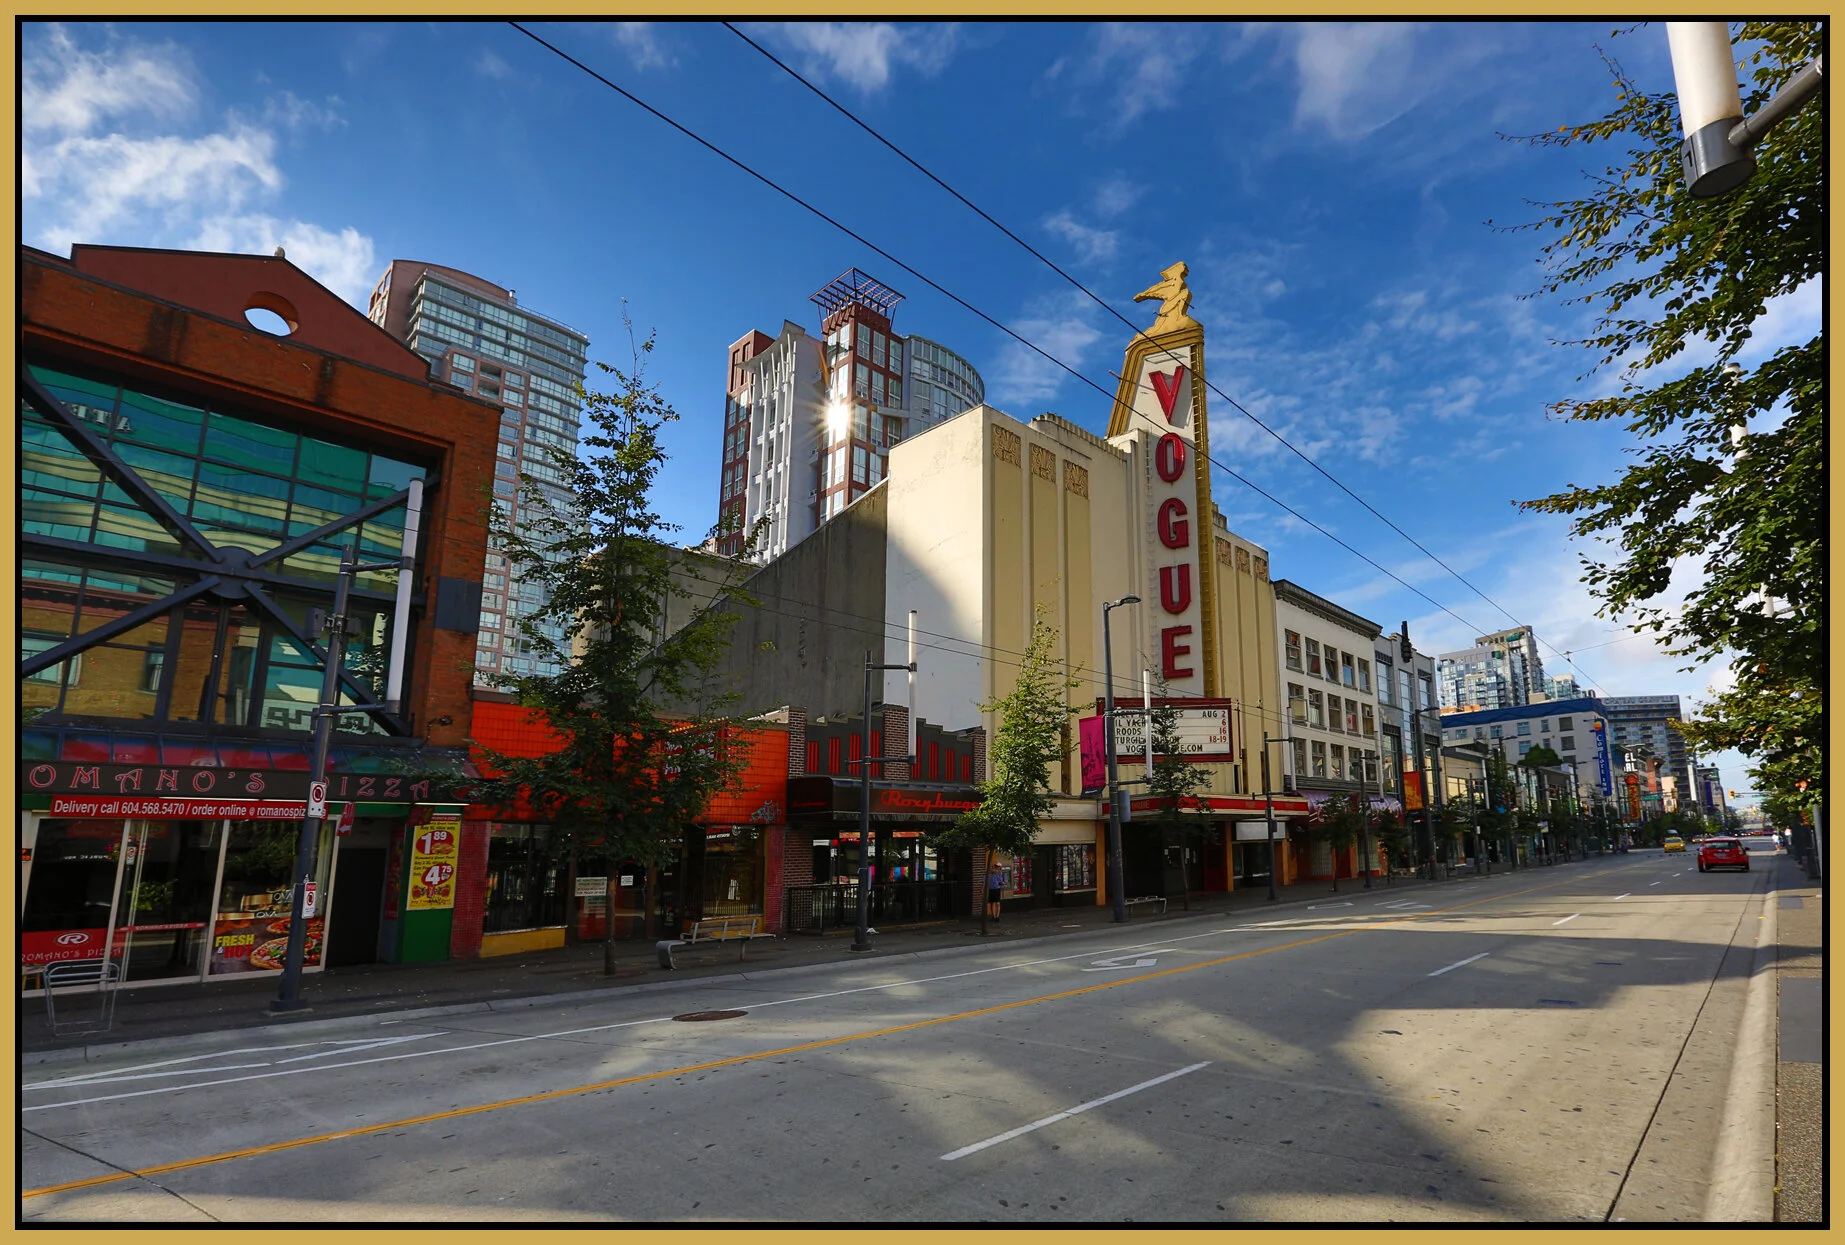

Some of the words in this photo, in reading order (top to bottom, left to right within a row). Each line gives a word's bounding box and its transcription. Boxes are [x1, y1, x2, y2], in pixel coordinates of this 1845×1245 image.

[1149, 366, 1194, 680] VOGUE
[1116, 728, 1141, 736] ROODS
[29, 764, 265, 794] OMANO'S
[324, 776, 430, 800] IZZA
[55, 800, 97, 816] Delivery
[100, 801, 119, 814] call
[121, 802, 184, 815] 604.568.5470
[192, 803, 216, 815] order
[218, 804, 246, 816] online
[880, 789, 981, 813] Roxyburge
[421, 832, 432, 855] 1
[433, 831, 447, 841] 89
[425, 865, 440, 885] 4
[441, 866, 452, 874] 75
[215, 934, 255, 947] FRESH
[217, 946, 224, 954] &
[223, 944, 254, 959] HOT
